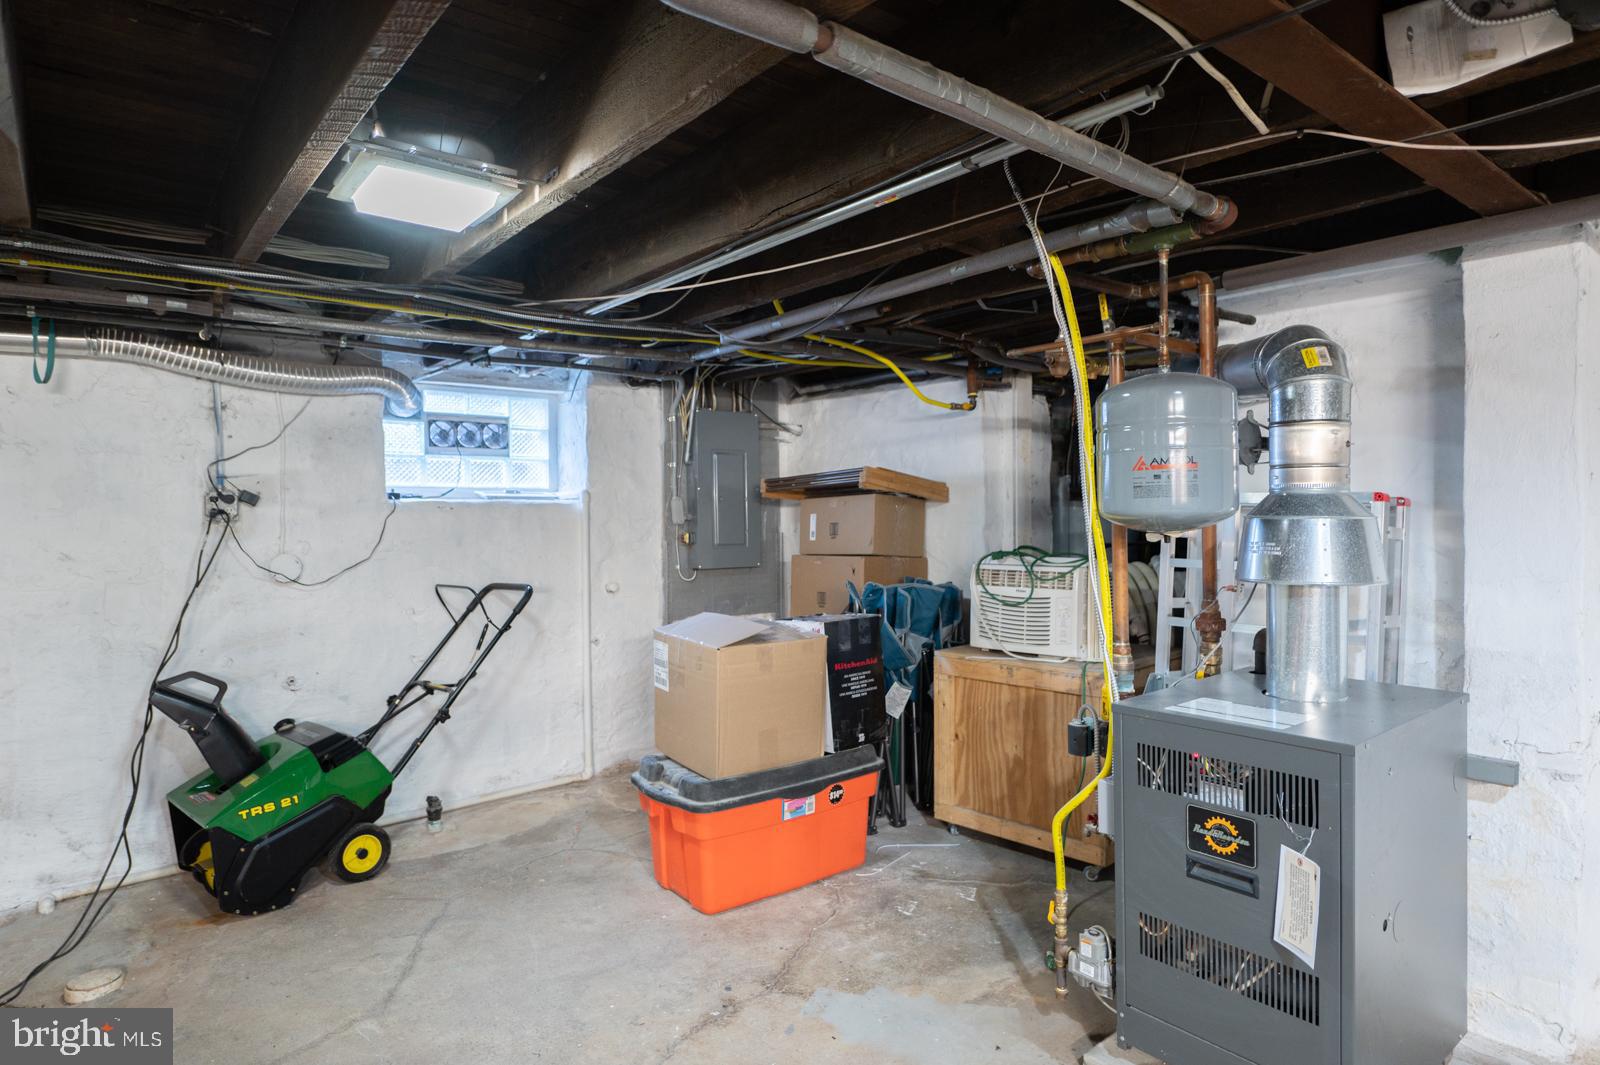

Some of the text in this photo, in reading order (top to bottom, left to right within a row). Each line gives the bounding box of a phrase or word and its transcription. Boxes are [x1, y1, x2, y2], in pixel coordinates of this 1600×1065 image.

[834, 658, 878, 671] KitchenAid
[238, 795, 299, 820] TRS 21
